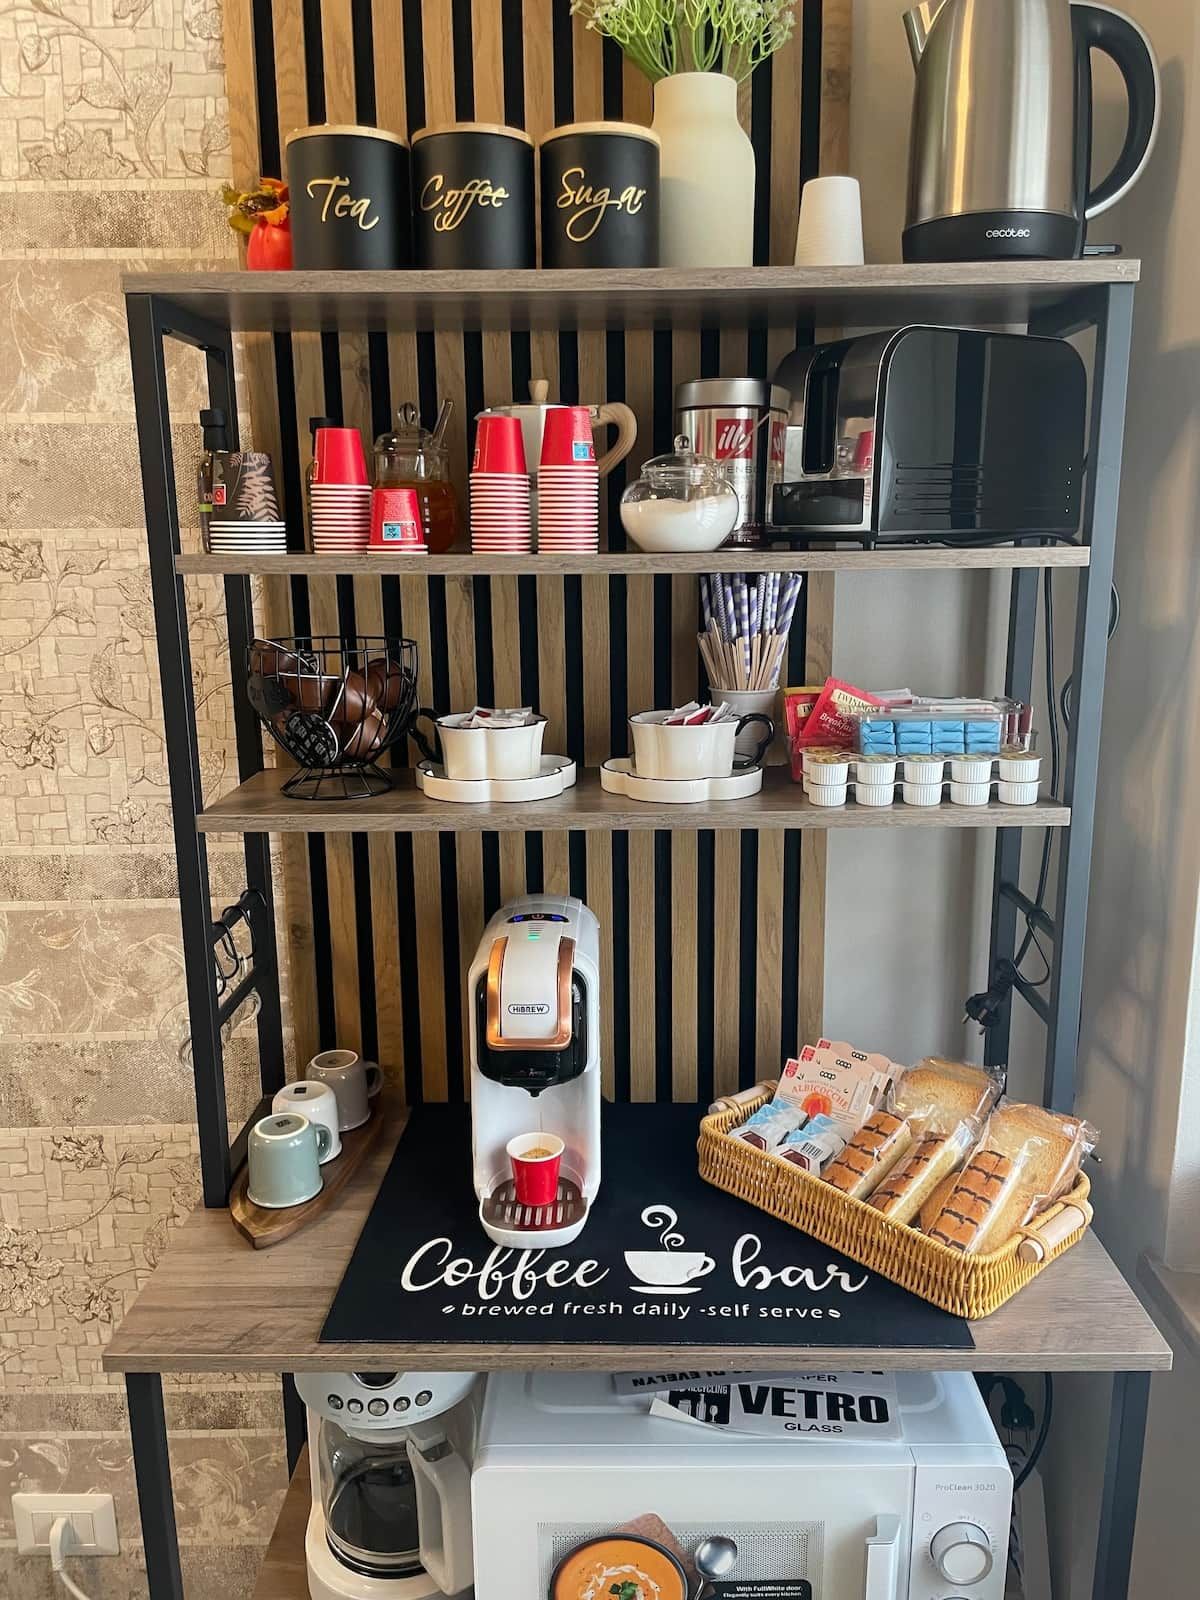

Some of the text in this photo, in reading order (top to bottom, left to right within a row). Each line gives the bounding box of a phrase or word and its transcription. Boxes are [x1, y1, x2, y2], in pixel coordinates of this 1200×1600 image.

[307, 175, 379, 231] Tea
[422, 174, 509, 232] Coffee
[557, 168, 646, 242] Sugar
[718, 425, 752, 456] illy
[819, 1071, 836, 1080] coop
[400, 1233, 868, 1300] Coffee bar
[462, 1303, 554, 1316] brewed
[563, 1302, 623, 1315] fresh
[632, 1302, 691, 1319] daily
[759, 1306, 823, 1318] serve
[737, 1383, 890, 1424] VETRO
[784, 1422, 843, 1433] GLASS
